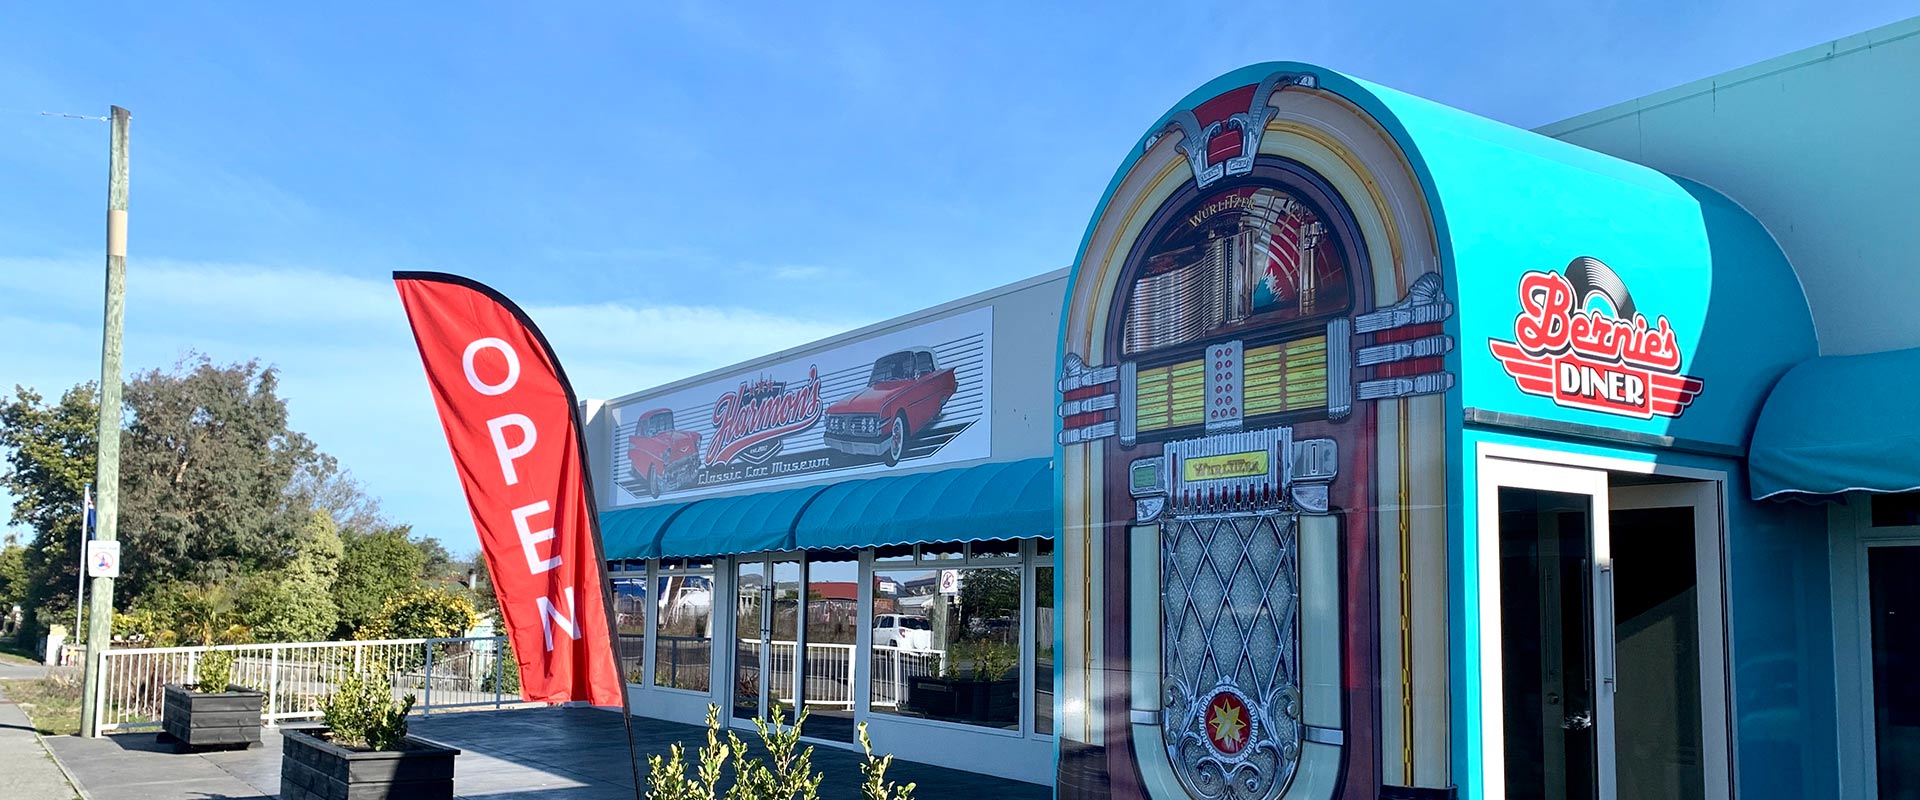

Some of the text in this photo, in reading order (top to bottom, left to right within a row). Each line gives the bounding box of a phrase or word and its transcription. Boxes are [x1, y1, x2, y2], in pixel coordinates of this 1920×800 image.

[1515, 270, 1682, 373] Bernie's
[704, 365, 822, 466] Harmon's
[1559, 361, 1645, 406] DINER
[462, 337, 582, 652] OPEN
[697, 457, 831, 486] Classic Car Museum
